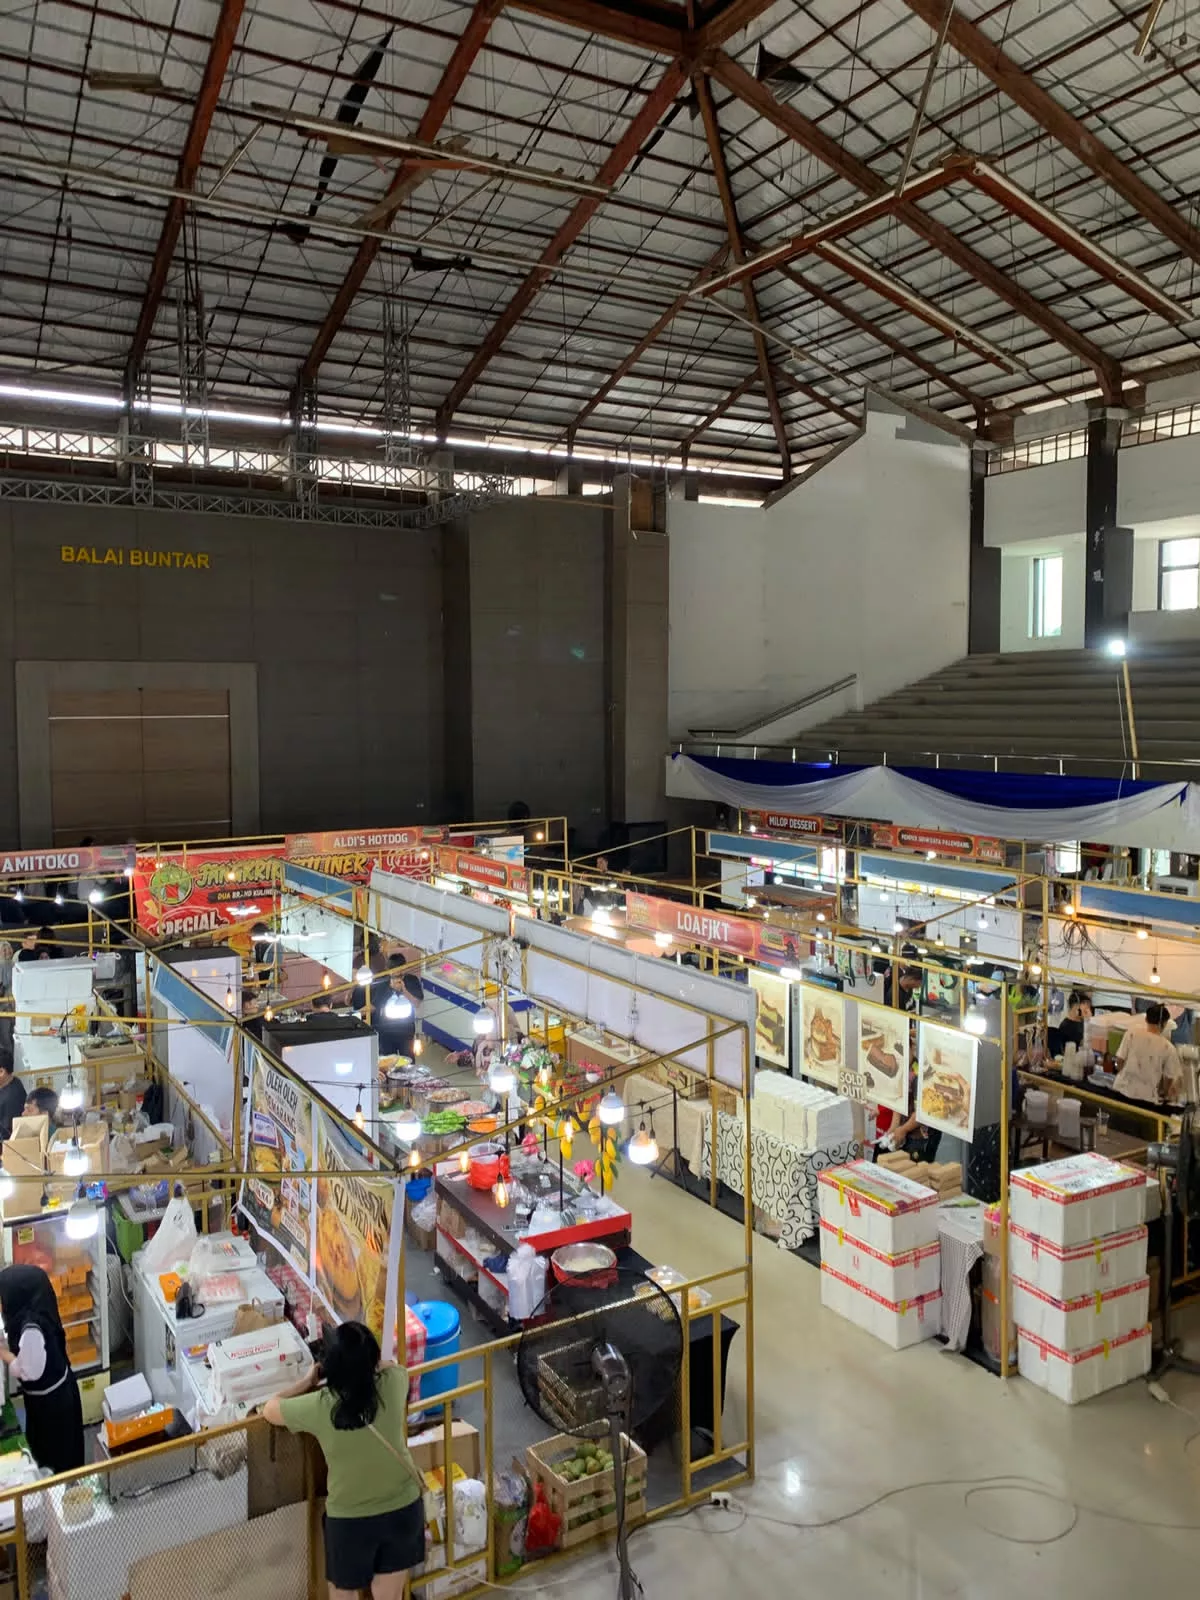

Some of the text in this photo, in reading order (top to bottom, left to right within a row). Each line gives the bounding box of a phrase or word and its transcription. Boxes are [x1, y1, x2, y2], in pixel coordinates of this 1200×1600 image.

[61, 545, 210, 569] BALAI BUNTAR
[789, 818, 818, 832] DESSERT
[333, 832, 408, 849] ALDI'S HOTDOG
[1, 853, 80, 874] AMITOKO
[677, 910, 729, 942] LOAFJKT
[840, 1071, 863, 1086] SOLD
[265, 1070, 281, 1093] OLEH
[282, 1082, 299, 1113] OLEH
